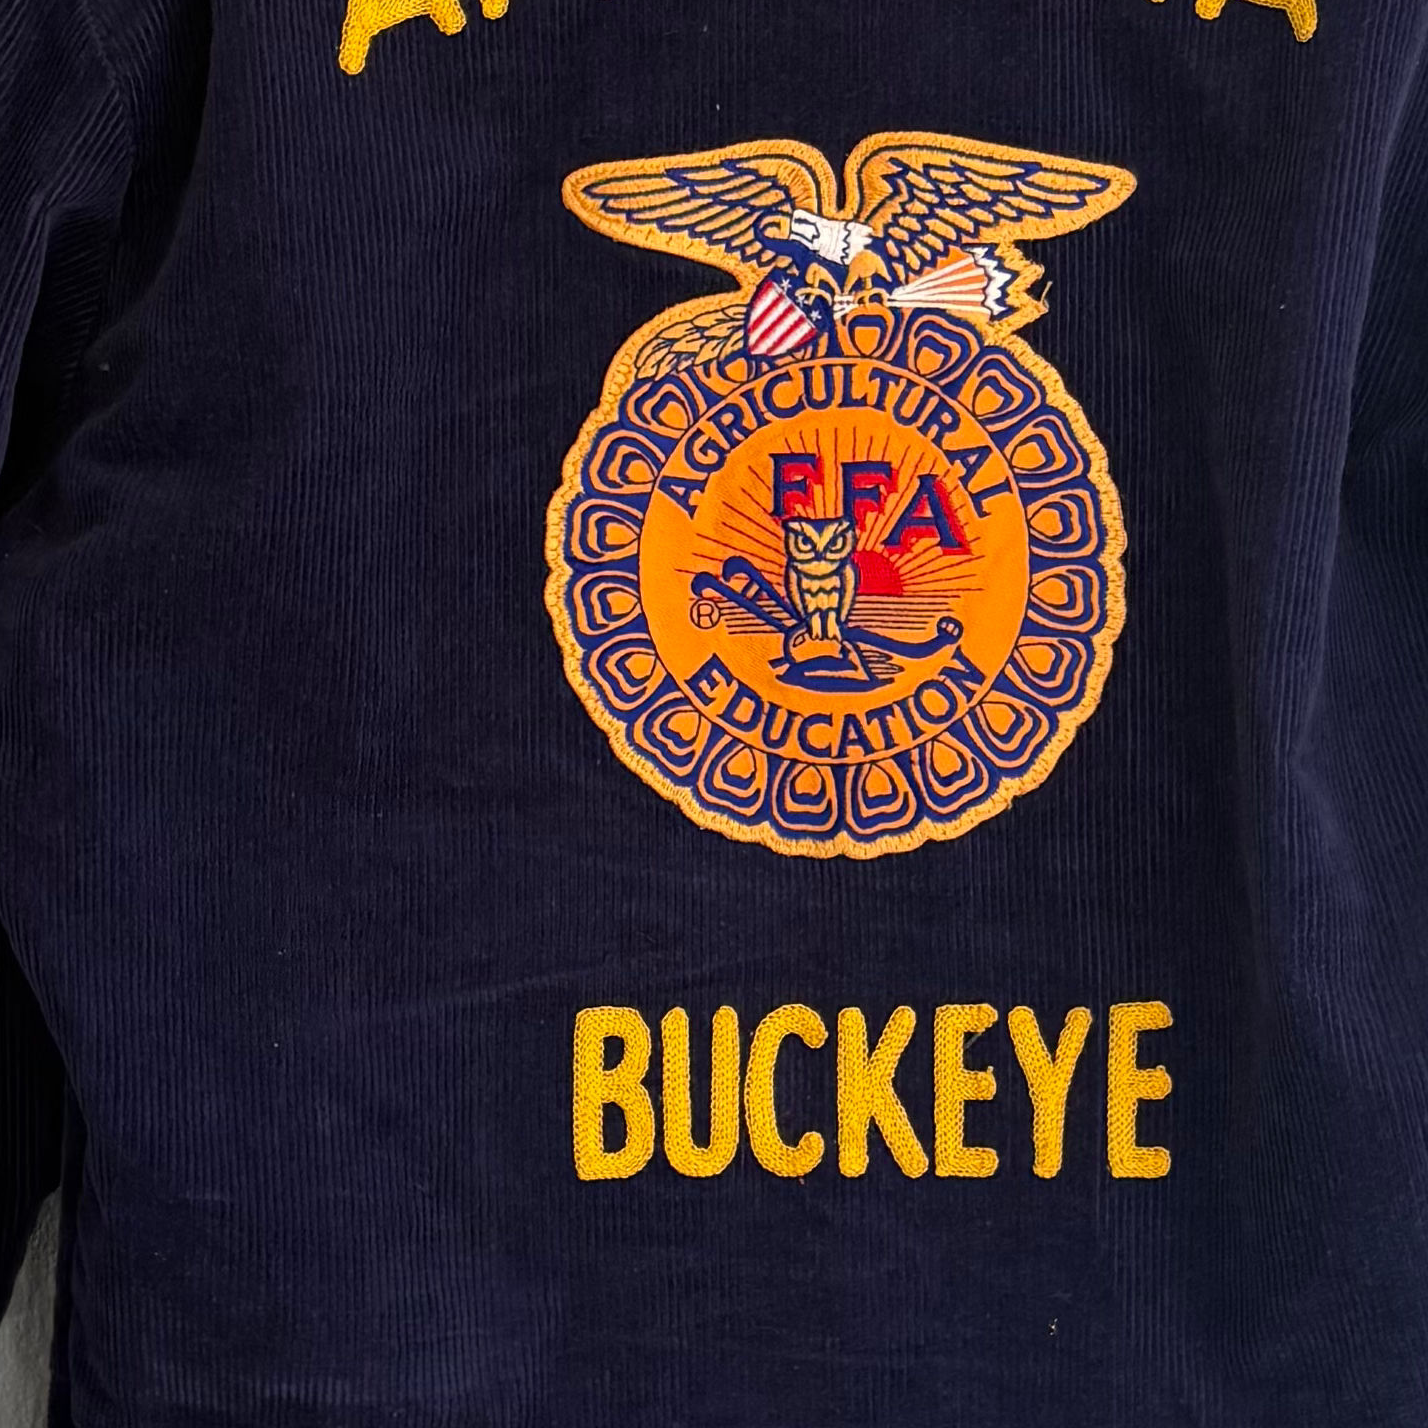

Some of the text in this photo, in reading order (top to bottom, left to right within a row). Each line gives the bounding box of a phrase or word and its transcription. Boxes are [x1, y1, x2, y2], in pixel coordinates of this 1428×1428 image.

[659, 364, 1014, 520] AGRICULTURAL
[770, 452, 970, 556] FFA
[682, 648, 993, 759] EDUCATION
[574, 1000, 1174, 1181] BUCKEYE
